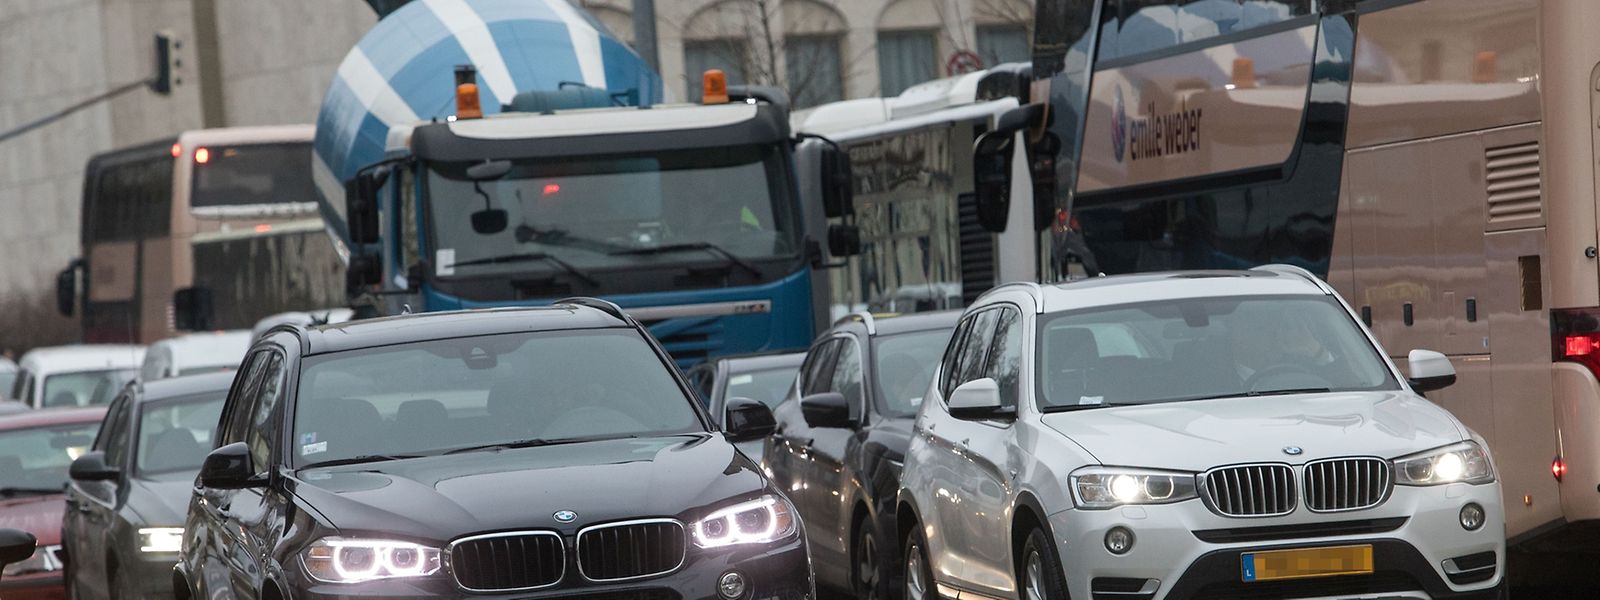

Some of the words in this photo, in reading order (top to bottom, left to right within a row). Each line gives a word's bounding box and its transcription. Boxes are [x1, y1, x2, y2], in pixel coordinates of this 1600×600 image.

[1130, 101, 1162, 160] emile
[1163, 95, 1202, 155] weber
[1246, 569, 1252, 577] L
